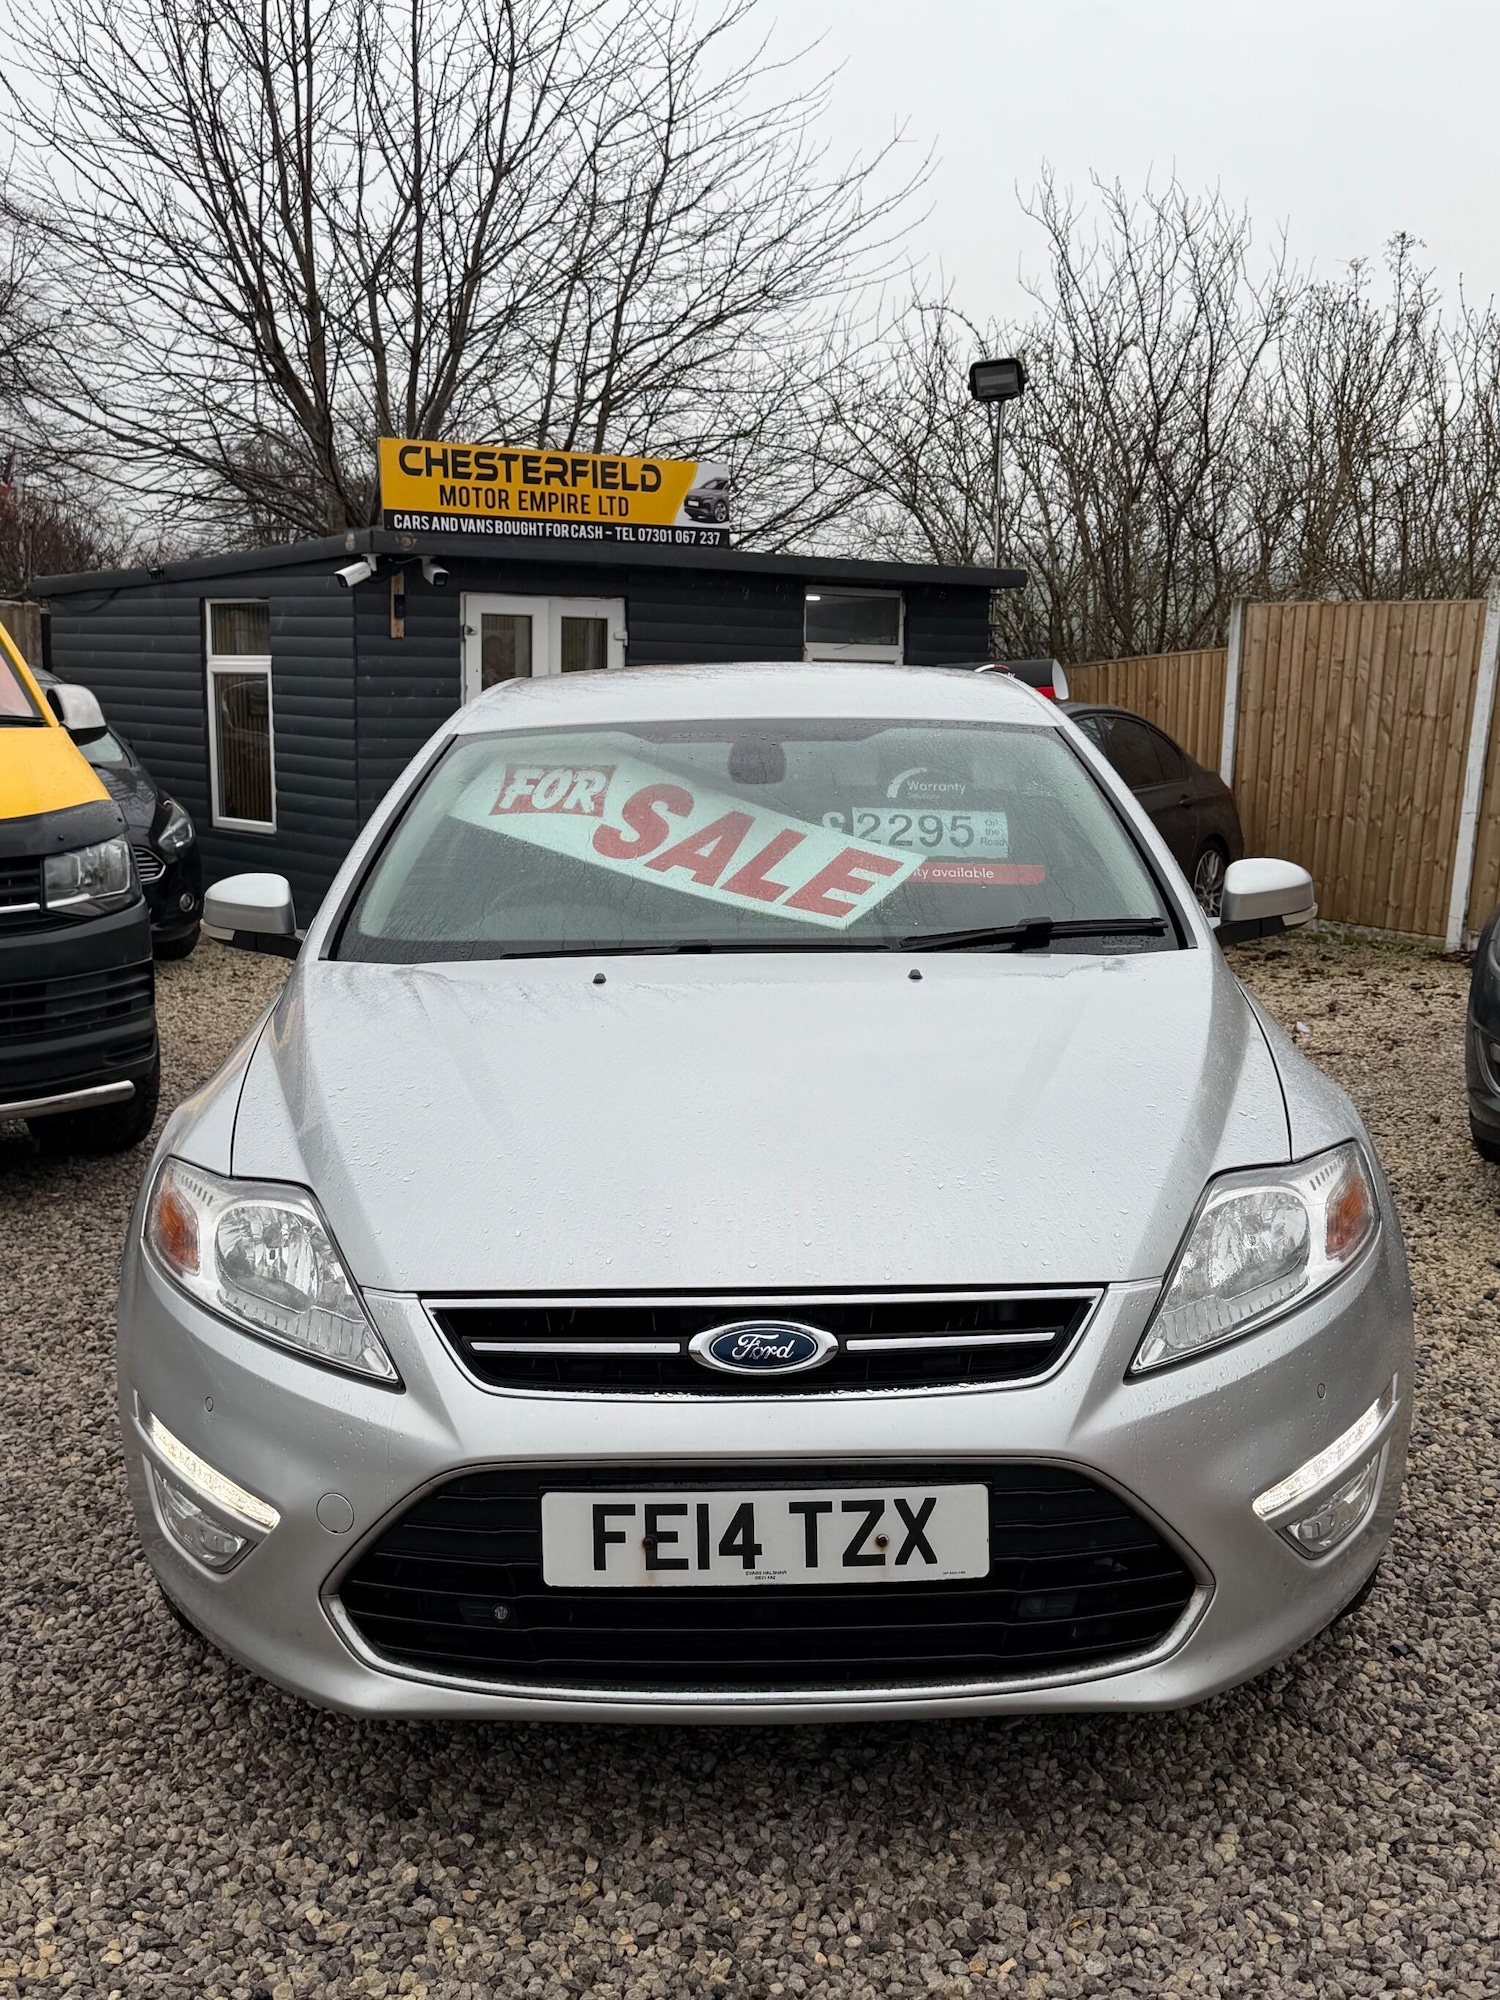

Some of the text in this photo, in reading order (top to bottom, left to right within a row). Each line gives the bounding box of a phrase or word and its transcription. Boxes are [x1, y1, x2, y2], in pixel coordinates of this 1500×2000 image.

[398, 445, 662, 492] CHESTERFIELD
[439, 484, 629, 517] MOTOR EMPIRE LTD
[393, 514, 430, 530] CARS
[431, 516, 459, 532] AND
[460, 518, 494, 534] VANS
[495, 520, 545, 537] BOUGHT
[545, 523, 570, 538] FOR
[571, 524, 603, 540] CASH
[615, 527, 636, 541] TEL
[638, 528, 672, 543] 07301
[675, 530, 696, 544] 067
[700, 532, 721, 545] 237
[907, 780, 966, 795] Warranty
[499, 768, 905, 918] FOR SALE
[980, 837, 1005, 846] Road
[985, 828, 1001, 836] the
[932, 867, 995, 879] available
[731, 1333, 796, 1360] Ford
[592, 1497, 938, 1571] FE14 TZX
